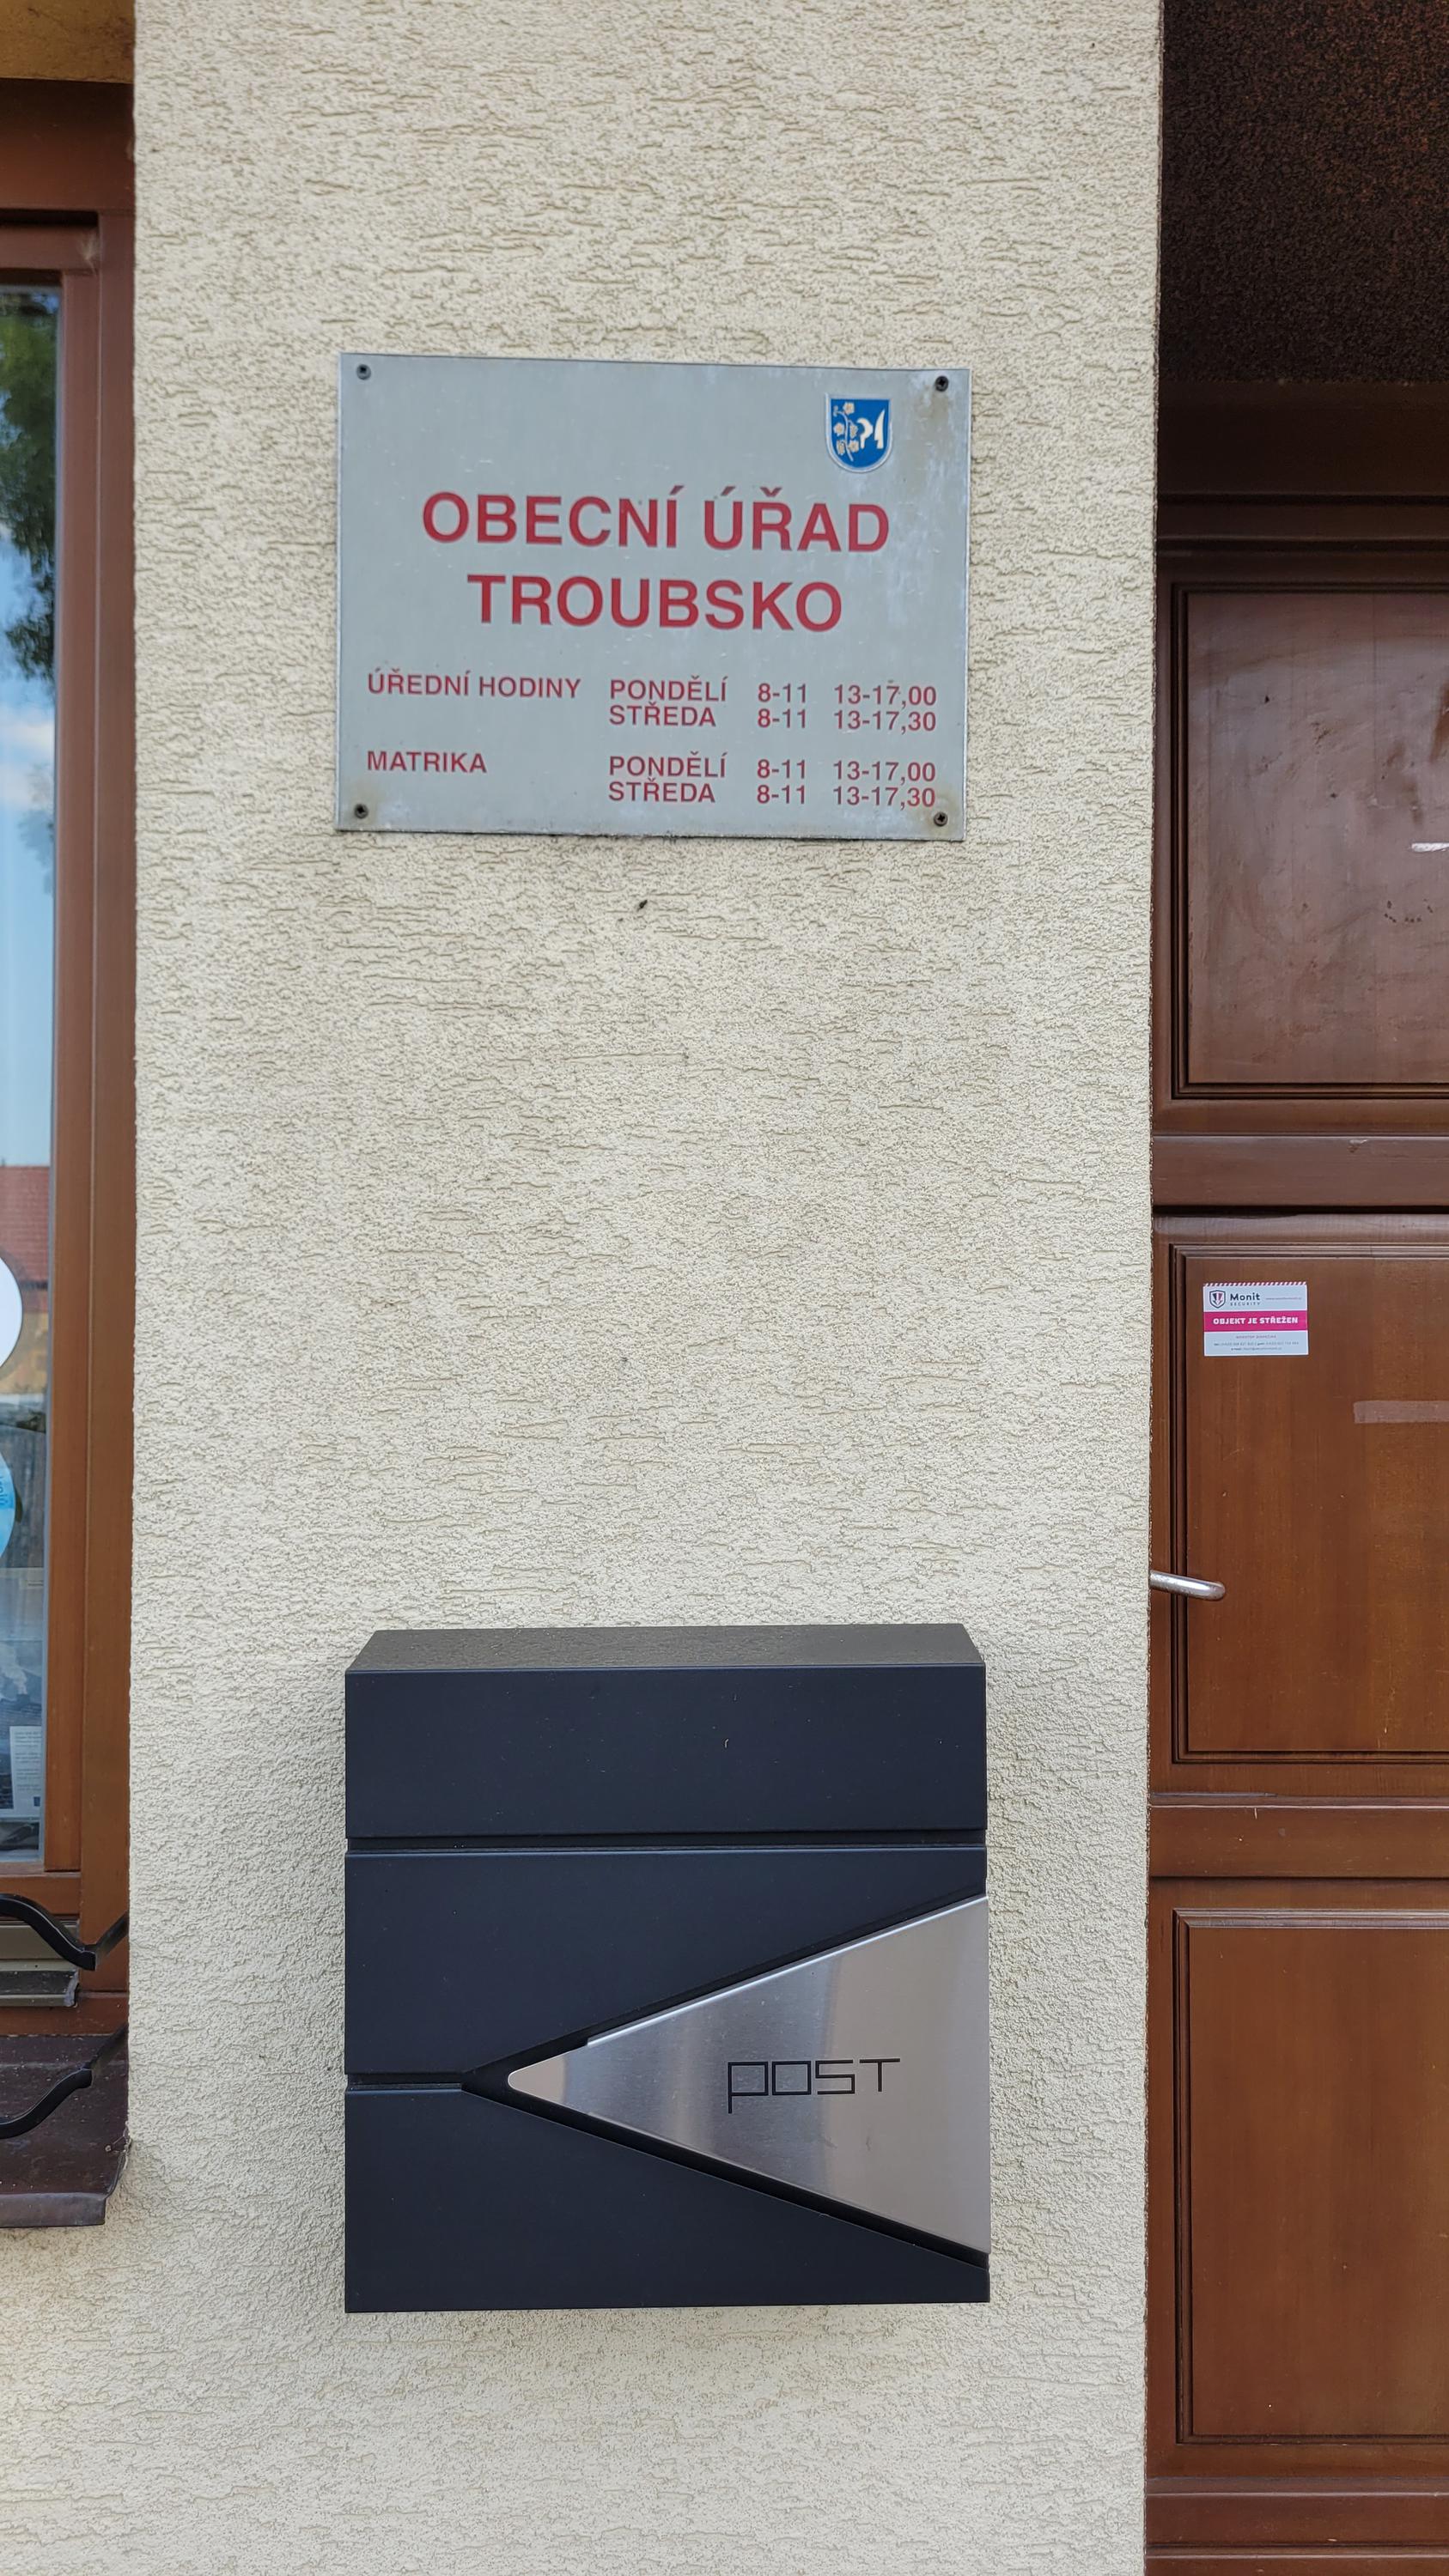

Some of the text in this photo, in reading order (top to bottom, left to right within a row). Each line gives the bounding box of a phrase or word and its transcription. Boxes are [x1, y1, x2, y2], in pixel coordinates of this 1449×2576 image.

[423, 485, 889, 552] OBECNÍ ÚŘAD
[467, 574, 842, 631] TROUBSKO
[368, 667, 937, 709] ÚŘEDNÍ HODINY PONDĚLÍ 8-11 13-17,00
[609, 701, 936, 735] STŘEDA 8-11 13-17,30
[367, 750, 936, 786] MATRIKA PONDĚLÍ 8-11 13-17,00
[608, 777, 935, 811] STŘEDA 8-11 13-17,30
[1229, 1292, 1261, 1302] Monit
[1259, 1315, 1299, 1324] STŘEŽEN
[728, 2058, 900, 2113] POST
